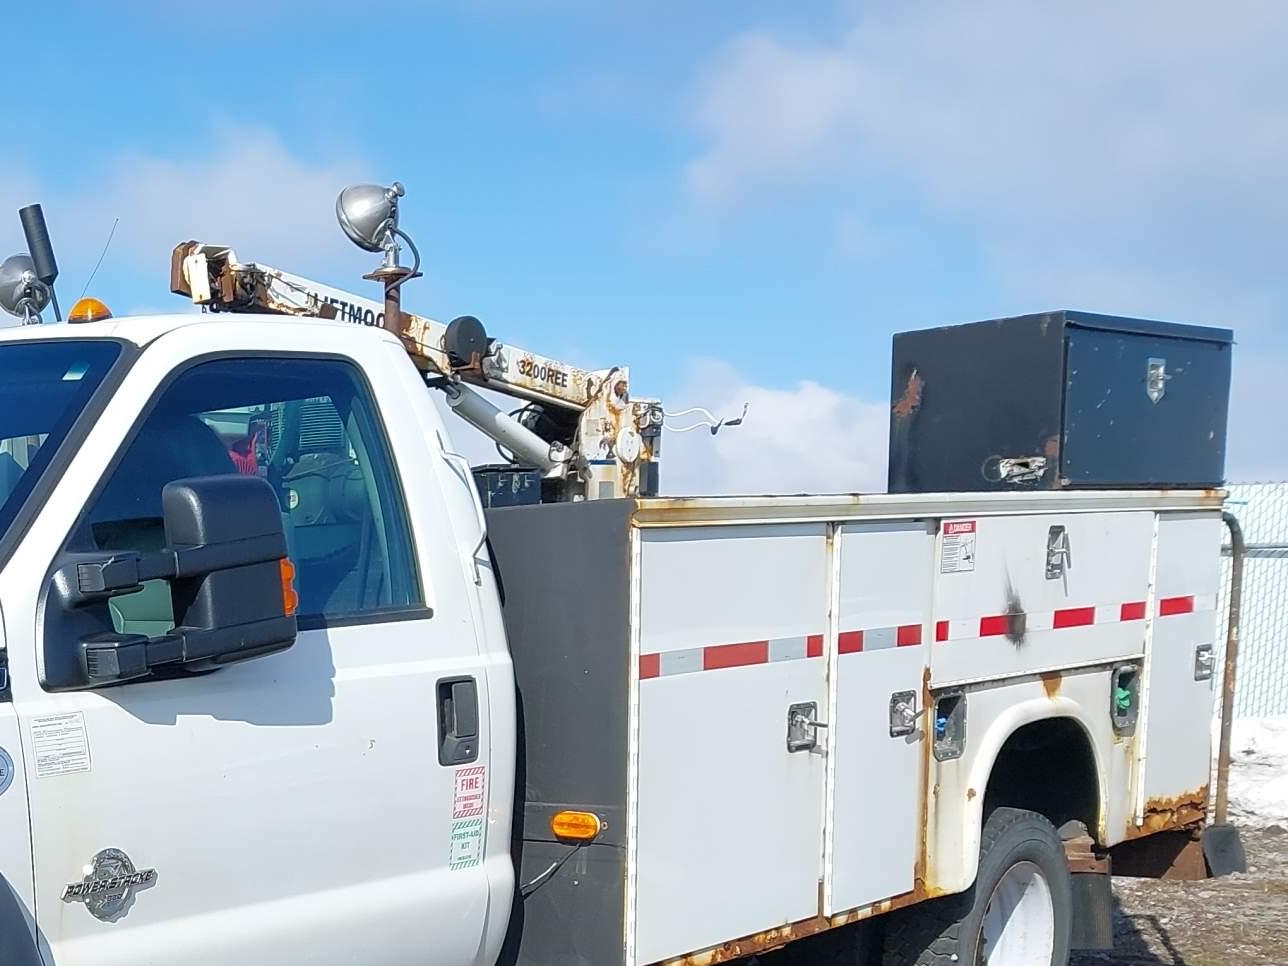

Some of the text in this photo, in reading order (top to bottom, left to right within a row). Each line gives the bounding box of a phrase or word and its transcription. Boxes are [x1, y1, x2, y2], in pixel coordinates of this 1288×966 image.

[518, 360, 569, 388] 3200REE
[460, 777, 479, 791] FIRE
[453, 830, 479, 840] FIRST-AID
